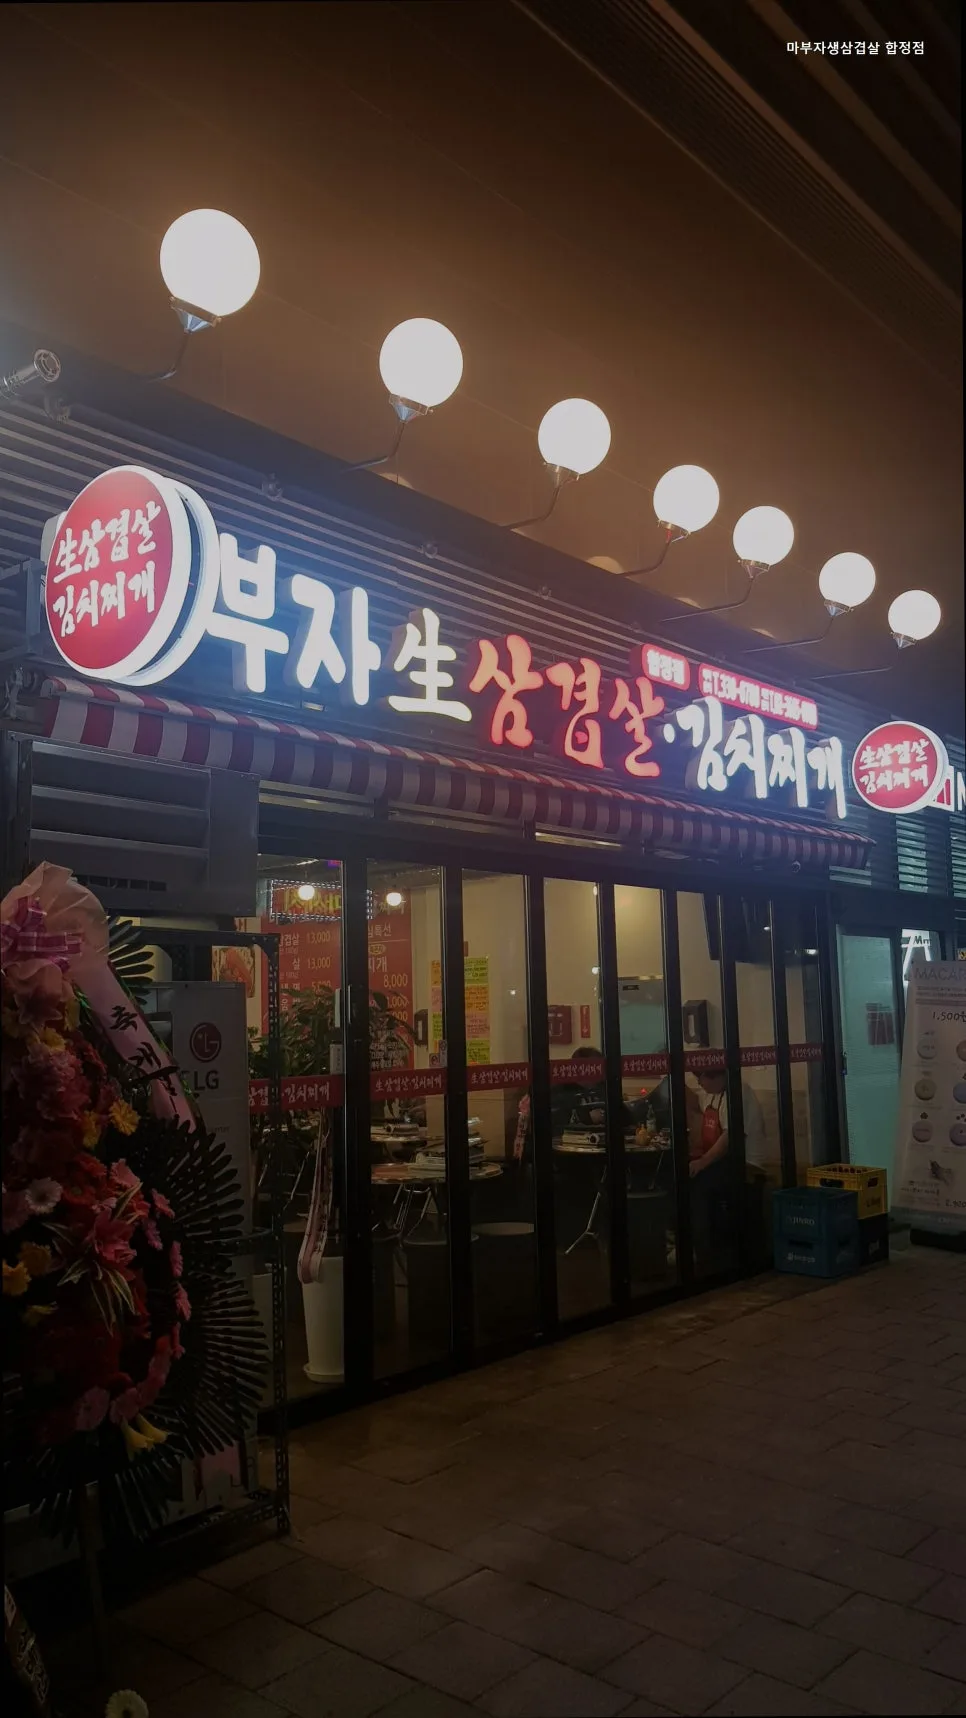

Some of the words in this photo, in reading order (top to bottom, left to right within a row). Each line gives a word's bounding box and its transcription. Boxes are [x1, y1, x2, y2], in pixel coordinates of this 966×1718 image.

[53, 561, 156, 638] 김치찌개
[383, 973, 408, 988] 8,000
[193, 1070, 219, 1091] LG
